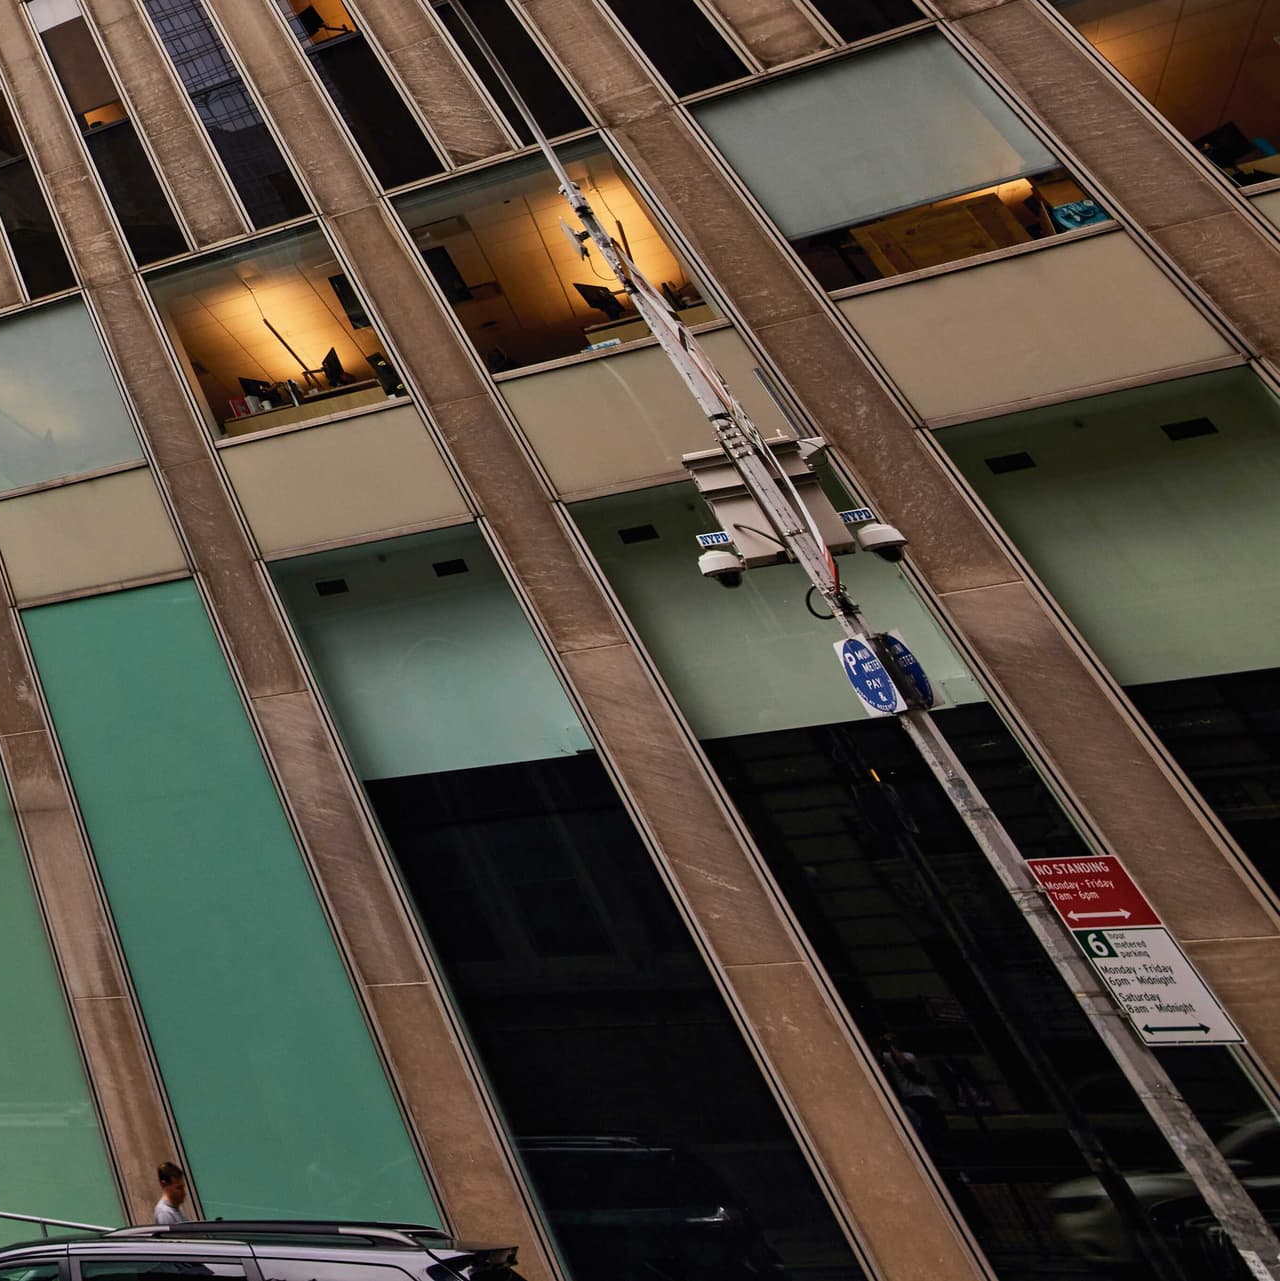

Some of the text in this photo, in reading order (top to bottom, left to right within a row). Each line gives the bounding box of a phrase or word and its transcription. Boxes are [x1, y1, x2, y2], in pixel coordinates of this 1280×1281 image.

[841, 509, 873, 524] NYPD
[698, 532, 729, 546] NYPD
[844, 653, 857, 676] P
[866, 677, 882, 690] PAY
[1034, 861, 1109, 876] NO STANDING
[1045, 880, 1079, 891] Monday
[1085, 878, 1115, 890] Friday
[1054, 891, 1072, 901] 7am
[1078, 890, 1100, 901] 6pm
[1087, 933, 1109, 957] 6
[1114, 940, 1147, 949] metered
[1120, 949, 1151, 959] parking
[1100, 966, 1136, 976] Monday
[1143, 963, 1174, 975] Friday
[1108, 976, 1129, 987] 6pm
[1137, 974, 1177, 986] Midnight
[1119, 992, 1161, 1003] Saturday
[1155, 1002, 1196, 1013] Midnight
